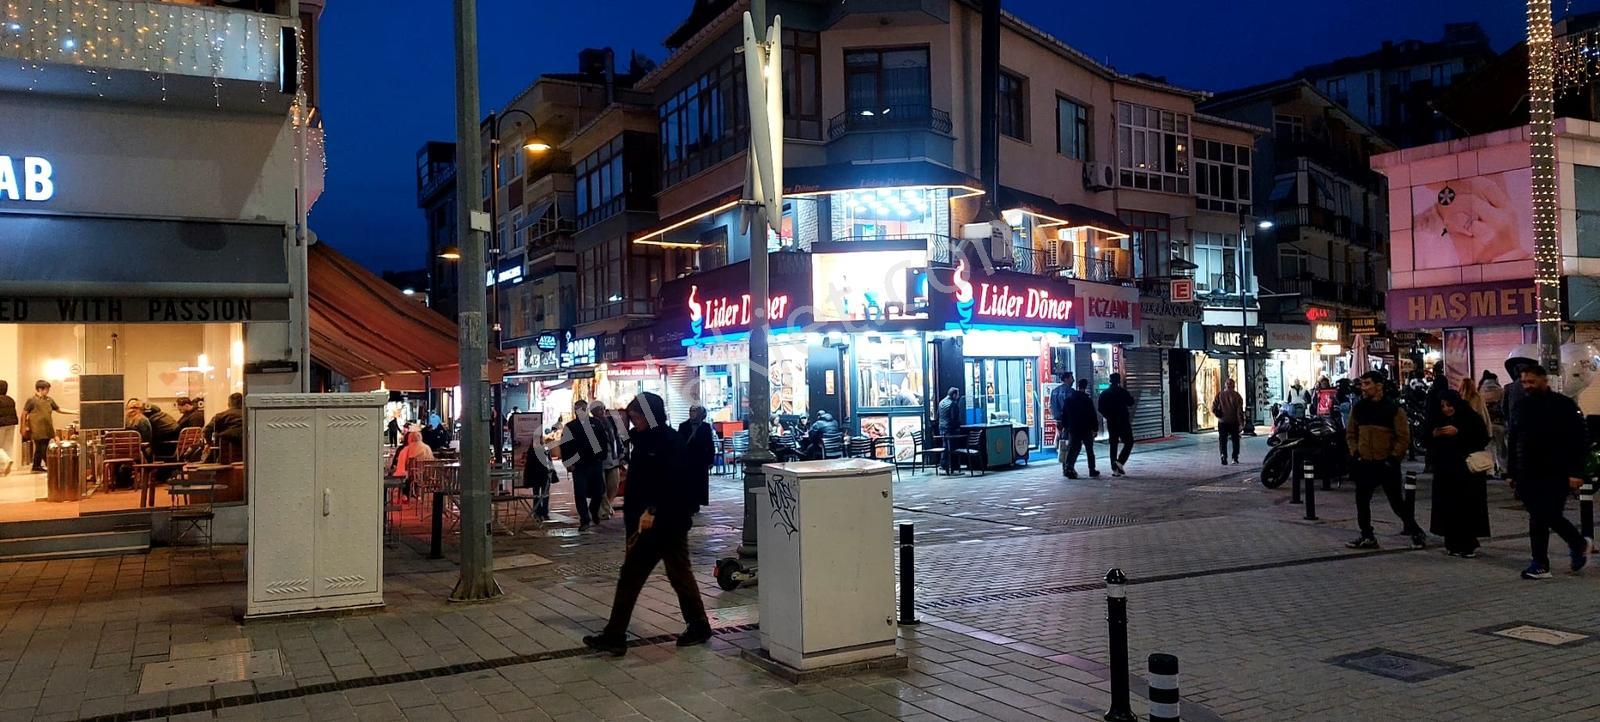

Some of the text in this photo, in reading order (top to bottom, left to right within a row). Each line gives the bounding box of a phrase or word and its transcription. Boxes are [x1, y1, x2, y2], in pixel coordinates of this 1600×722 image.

[58, 300, 123, 321] WITH
[150, 300, 252, 321] PASSION
[704, 294, 787, 329] Lider Der
[978, 283, 1072, 320] Lider Döner
[1408, 287, 1537, 321] HAŞMET
